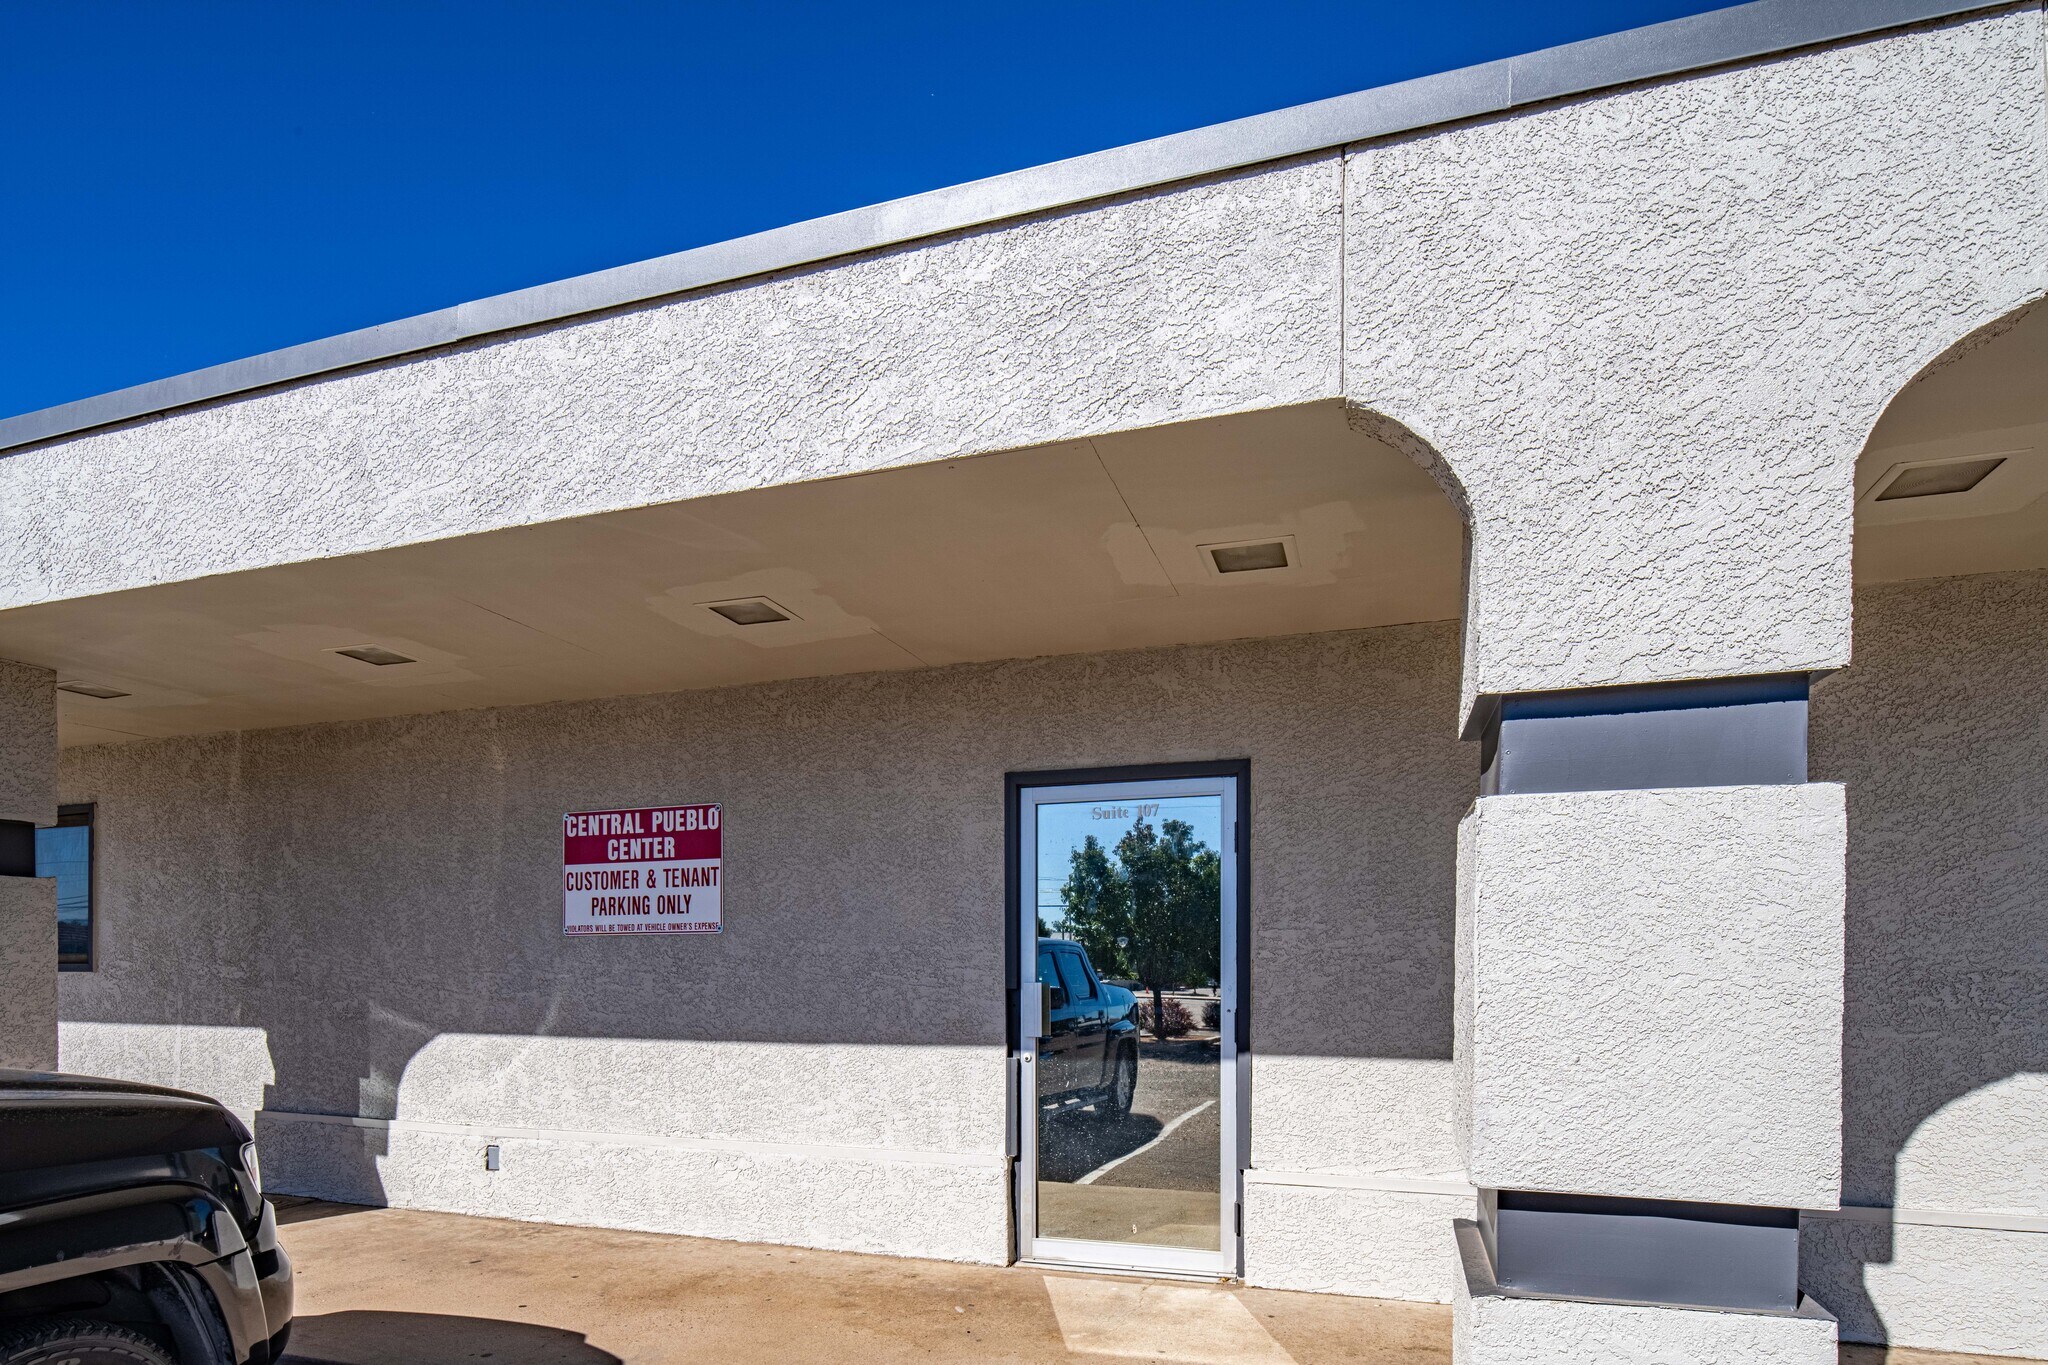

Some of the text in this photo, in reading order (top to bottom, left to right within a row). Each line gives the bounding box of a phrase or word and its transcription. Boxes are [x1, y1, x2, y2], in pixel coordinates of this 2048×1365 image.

[566, 808, 719, 837] CENTRAL PUEBLO
[1092, 804, 1159, 820] Suite 107
[607, 837, 675, 861] CENTER
[566, 866, 719, 891] CUSTOMER & TENANT
[591, 894, 691, 916] PARKING ONLY
[595, 924, 606, 932] WILL
[637, 923, 643, 931] AT
[645, 923, 665, 931] VEHICLE
[668, 922, 692, 930] OWNER'S
